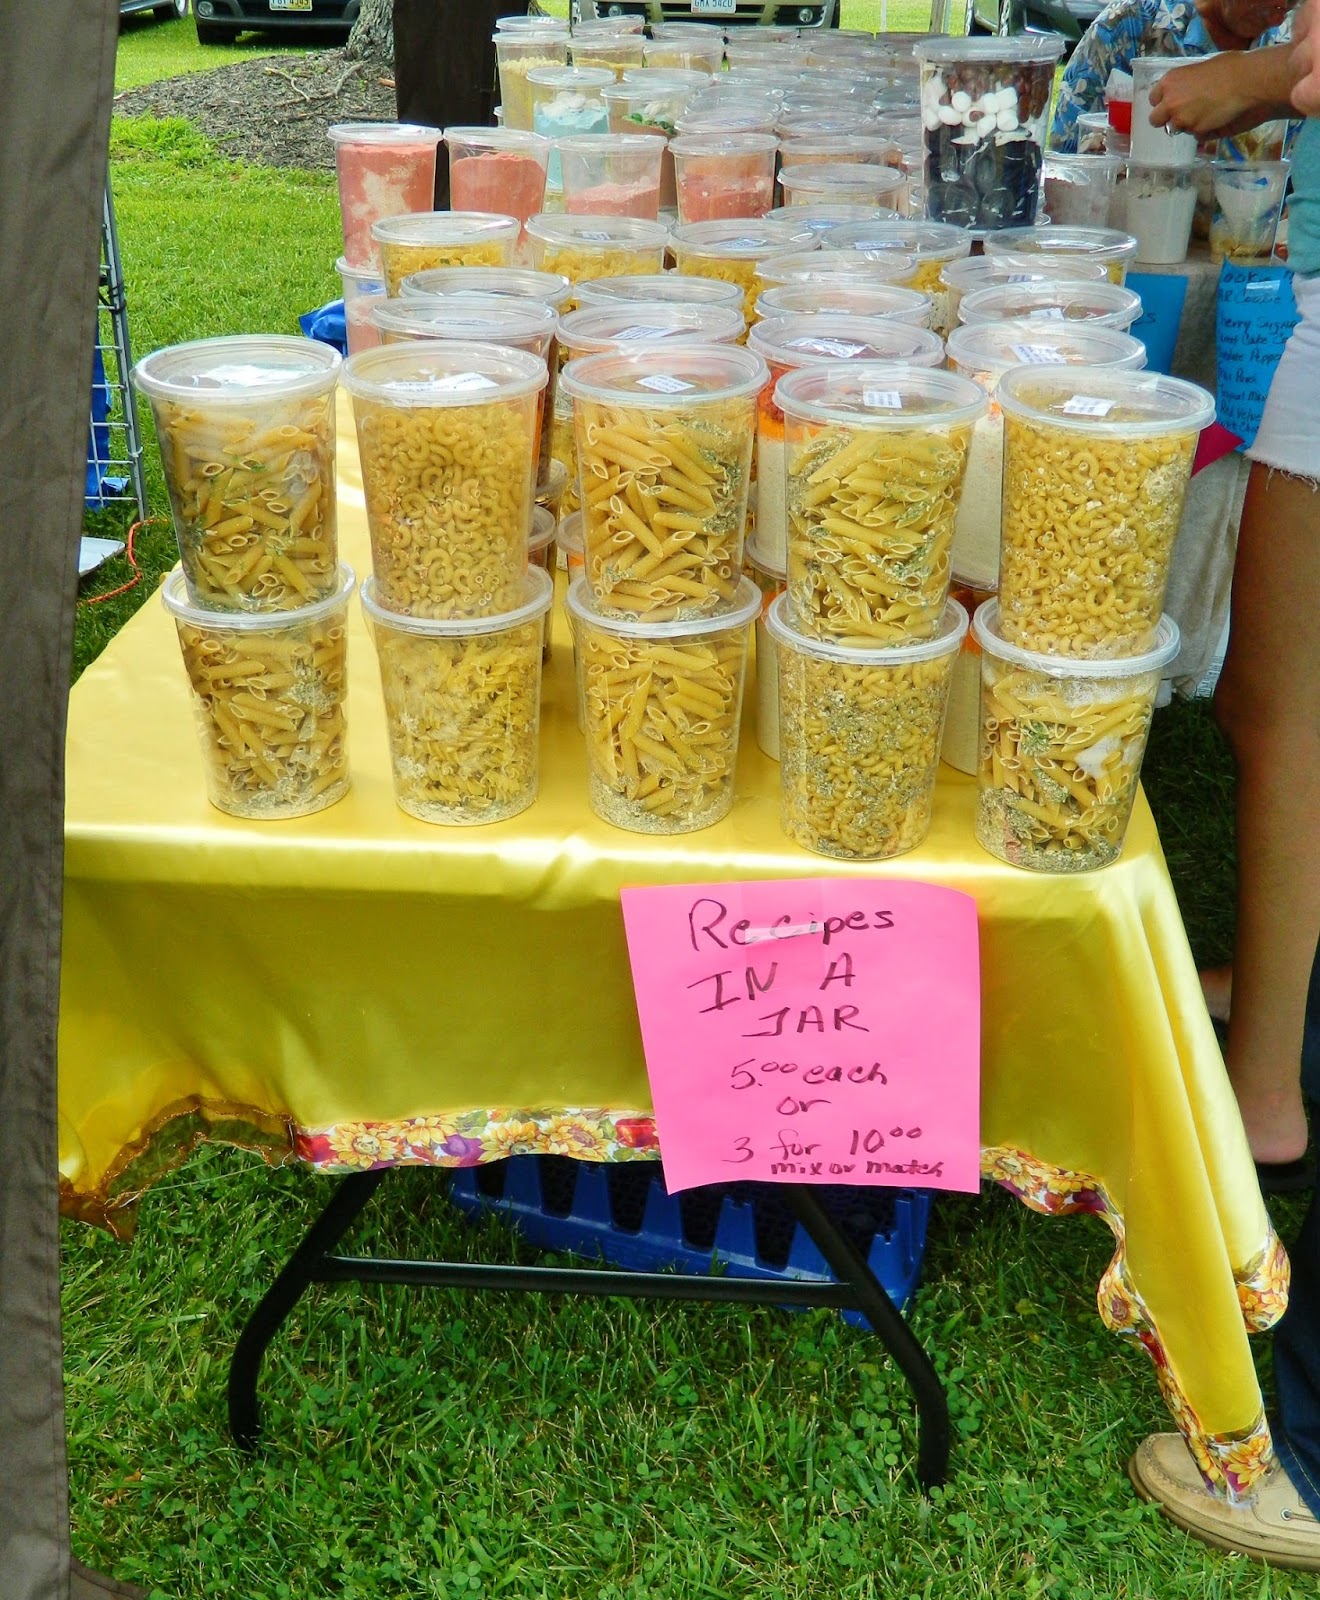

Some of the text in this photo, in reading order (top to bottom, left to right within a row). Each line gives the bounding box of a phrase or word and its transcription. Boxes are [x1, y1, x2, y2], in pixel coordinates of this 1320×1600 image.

[1237, 407, 1262, 422] Velve
[688, 898, 895, 952] Recipes
[686, 952, 856, 1013] IN A
[741, 1005, 870, 1038] JAR
[802, 1062, 888, 1085] each
[776, 1096, 832, 1116] or
[721, 1136, 754, 1163] 3
[770, 1129, 822, 1159] for
[770, 1160, 945, 1177] mix or match
